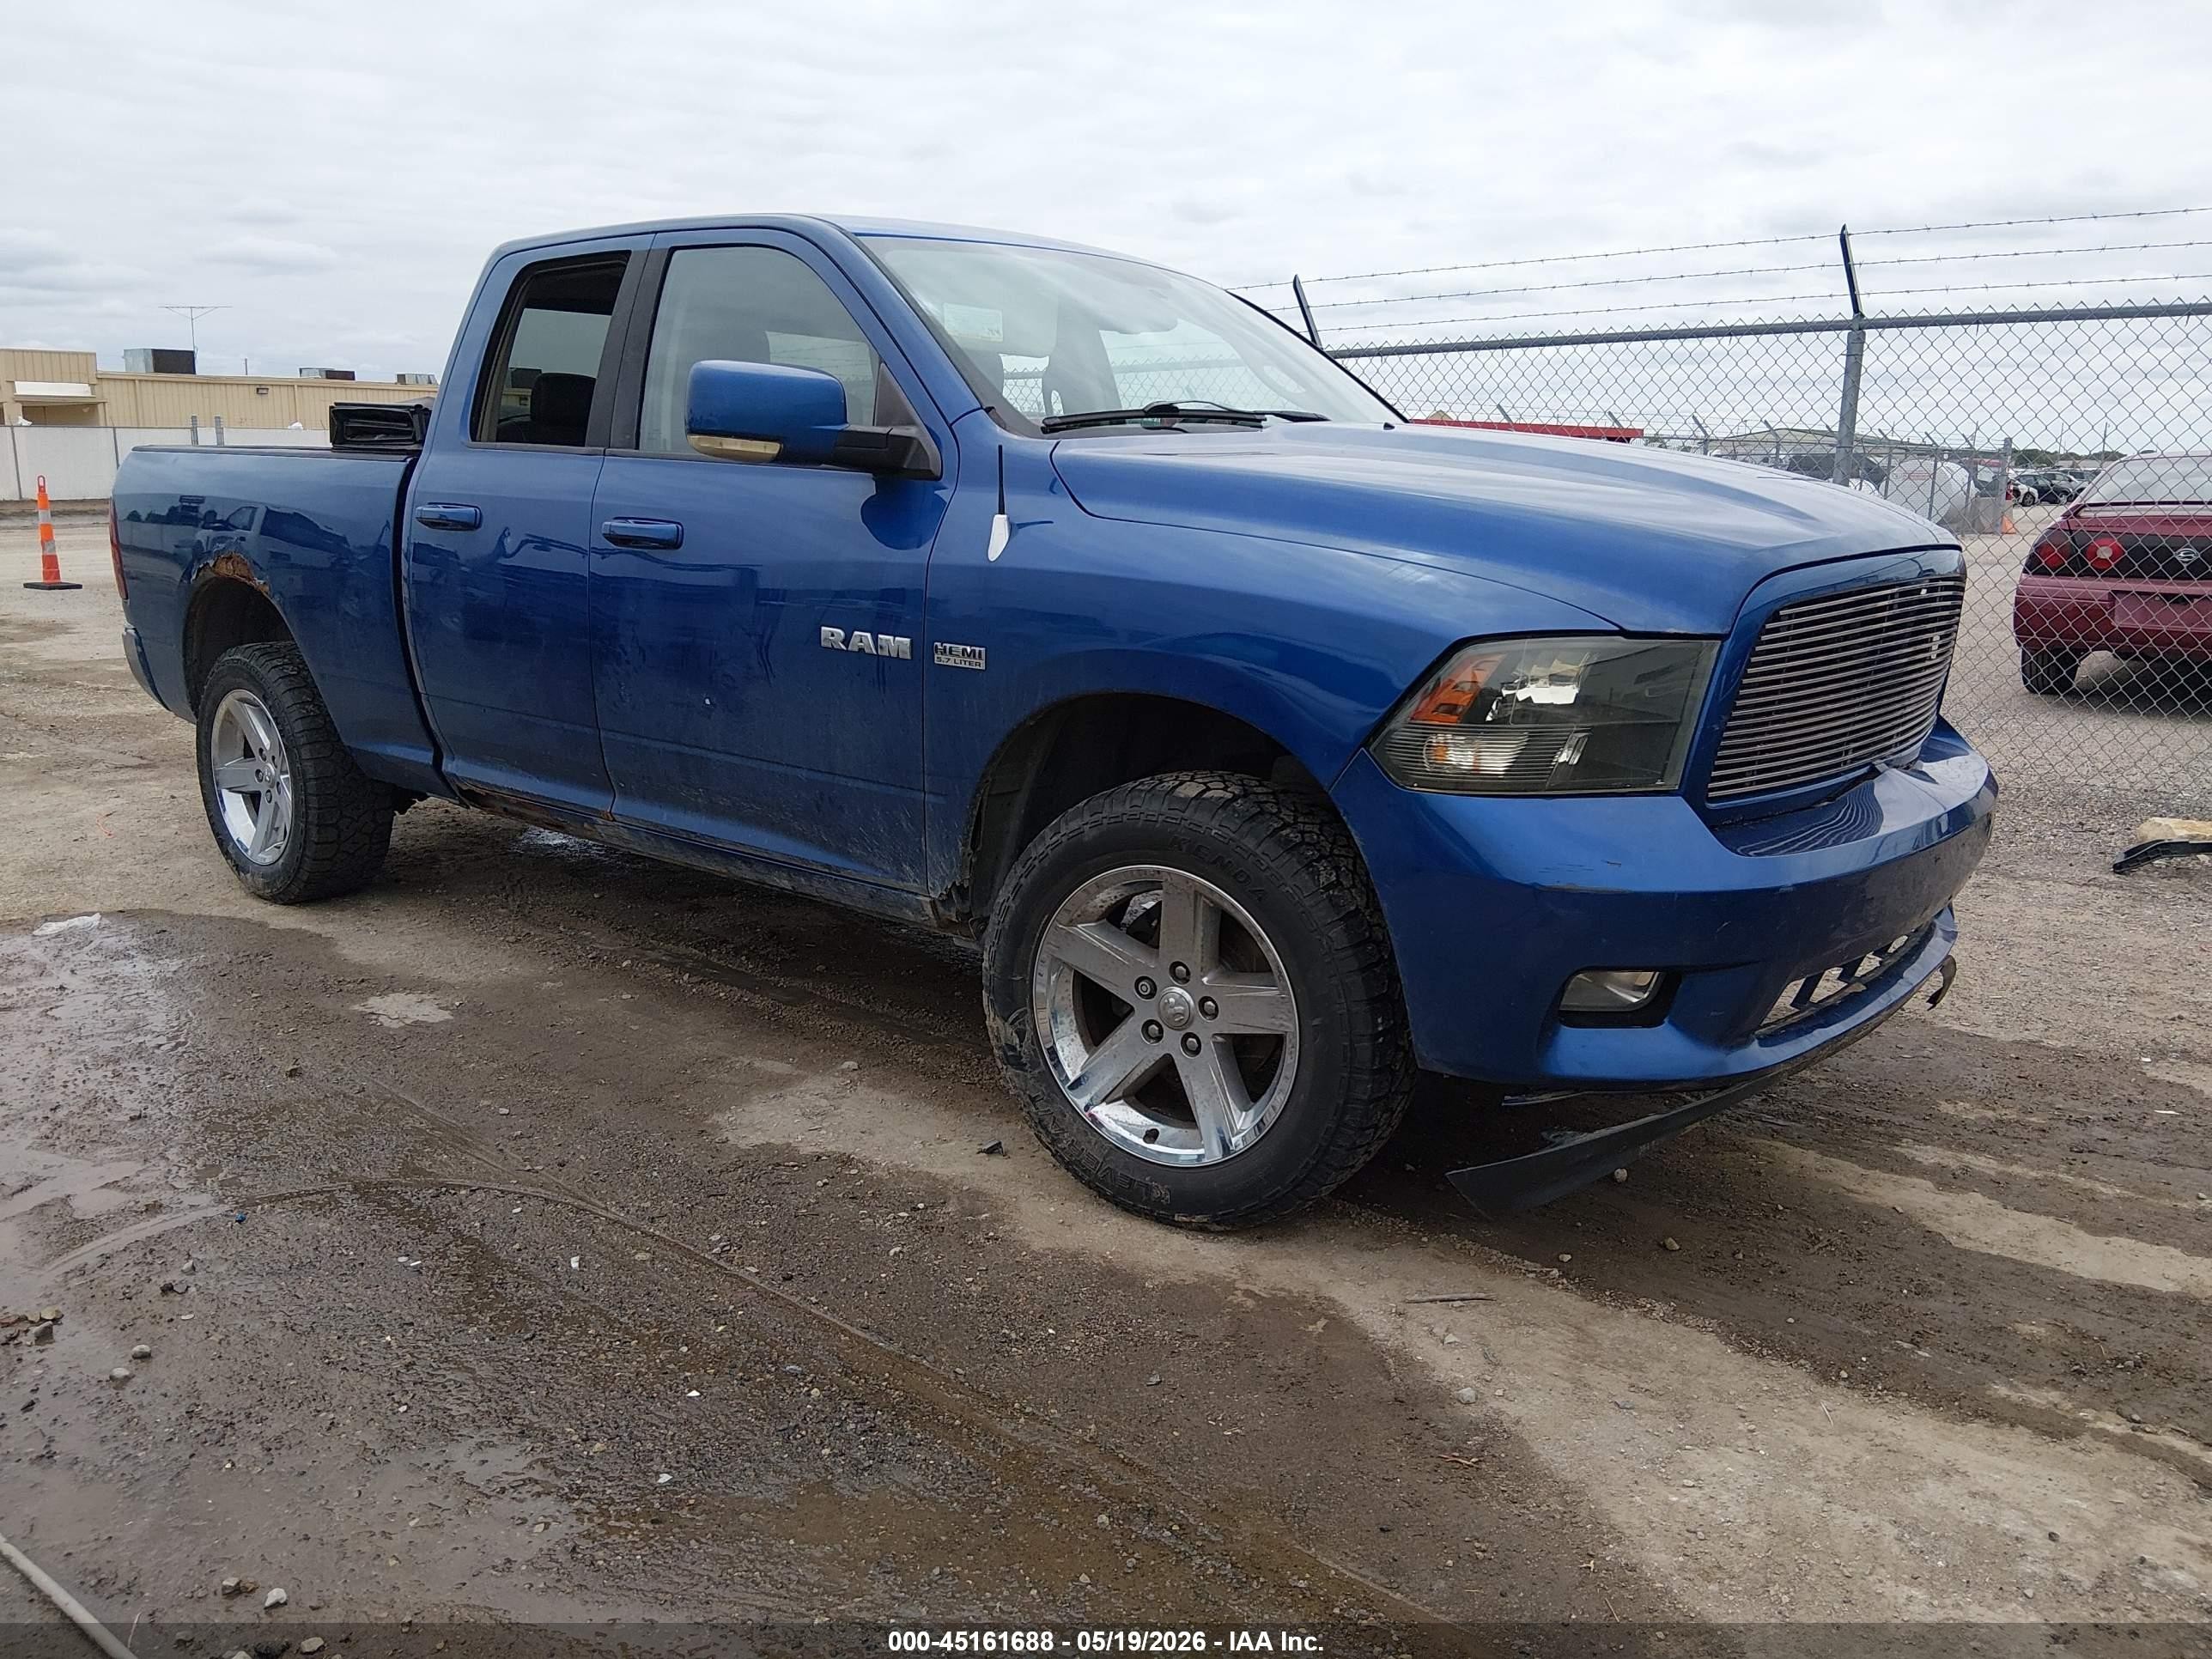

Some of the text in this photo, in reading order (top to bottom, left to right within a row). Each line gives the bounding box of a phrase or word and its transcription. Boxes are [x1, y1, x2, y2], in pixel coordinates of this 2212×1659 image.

[821, 626, 912, 660] RAM
[934, 643, 983, 660] HEMI
[953, 658, 982, 668] LITER
[1168, 835, 1266, 903] KENDA
